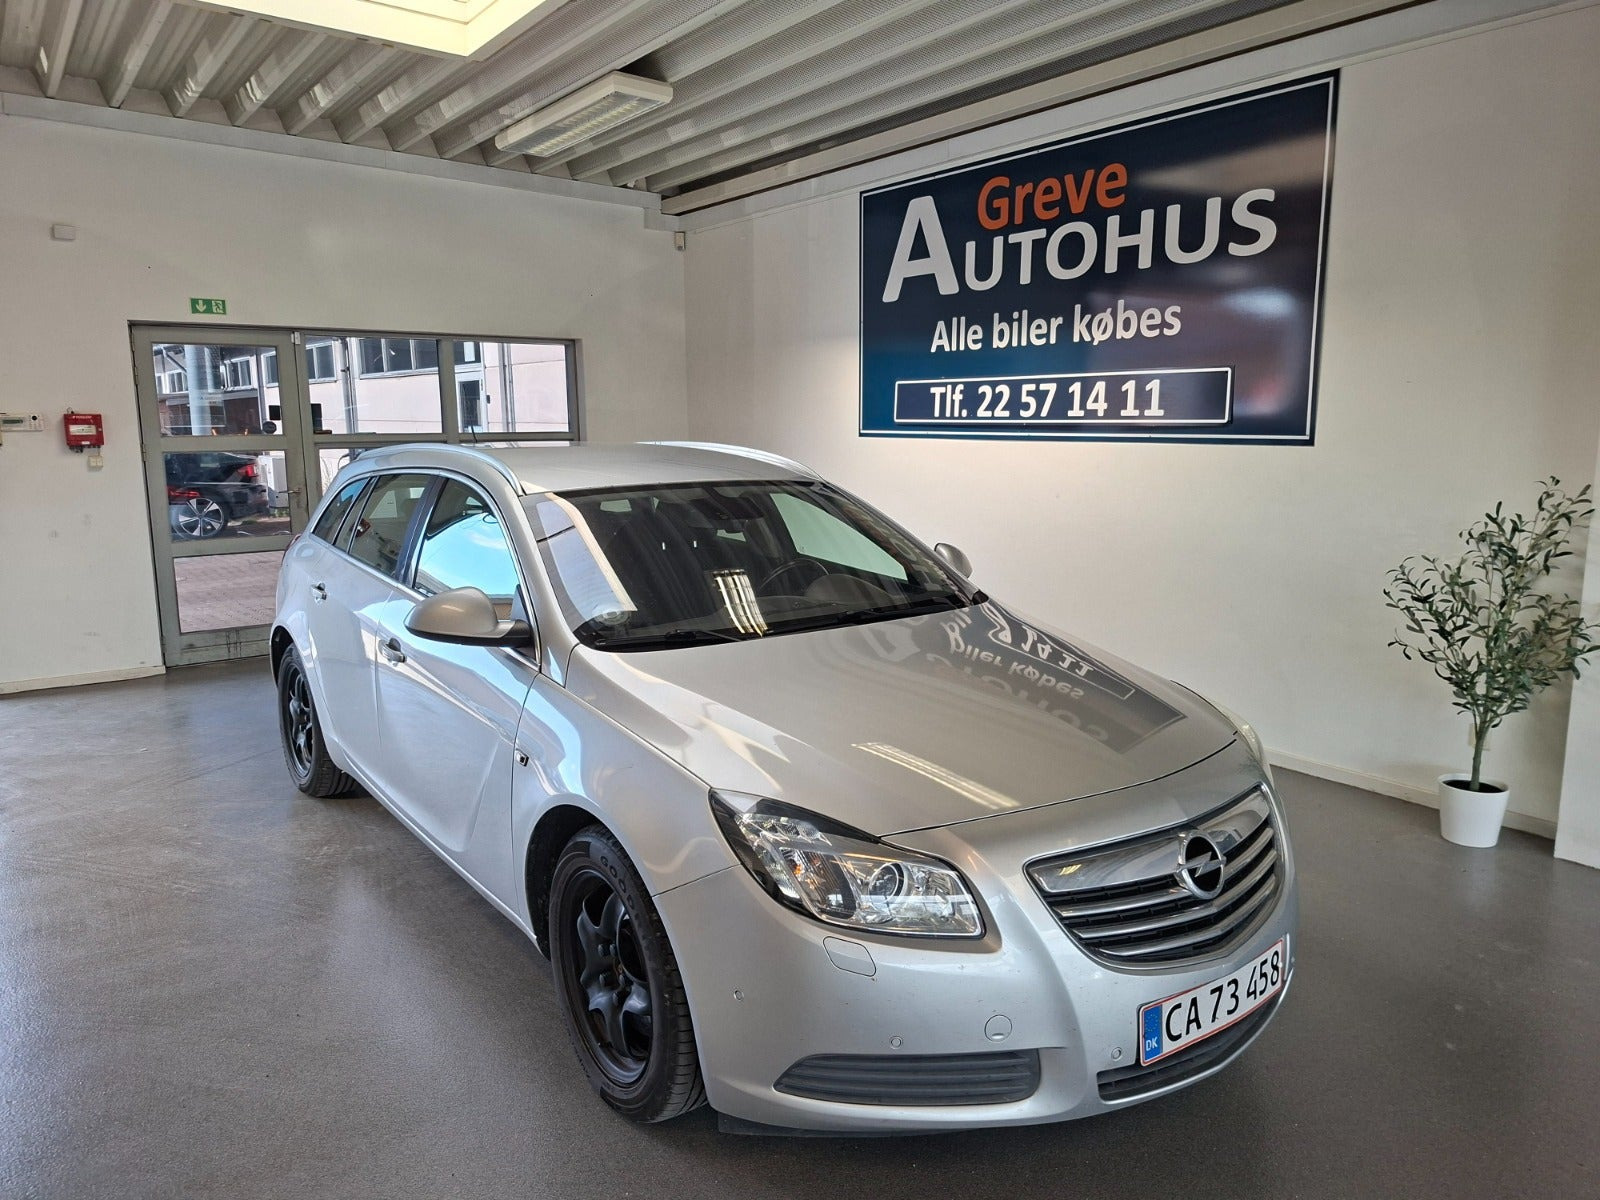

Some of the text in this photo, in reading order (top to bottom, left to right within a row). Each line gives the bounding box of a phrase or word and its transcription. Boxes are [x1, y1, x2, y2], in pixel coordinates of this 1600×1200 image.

[978, 163, 1127, 229] Greve
[882, 188, 1278, 303] AUTOHUS
[930, 300, 1182, 353] Alle biler købes
[930, 379, 1165, 418] Tlf. 22 57 14 11
[1165, 950, 1280, 1042] CA 73 458
[1145, 1036, 1158, 1051] DK
